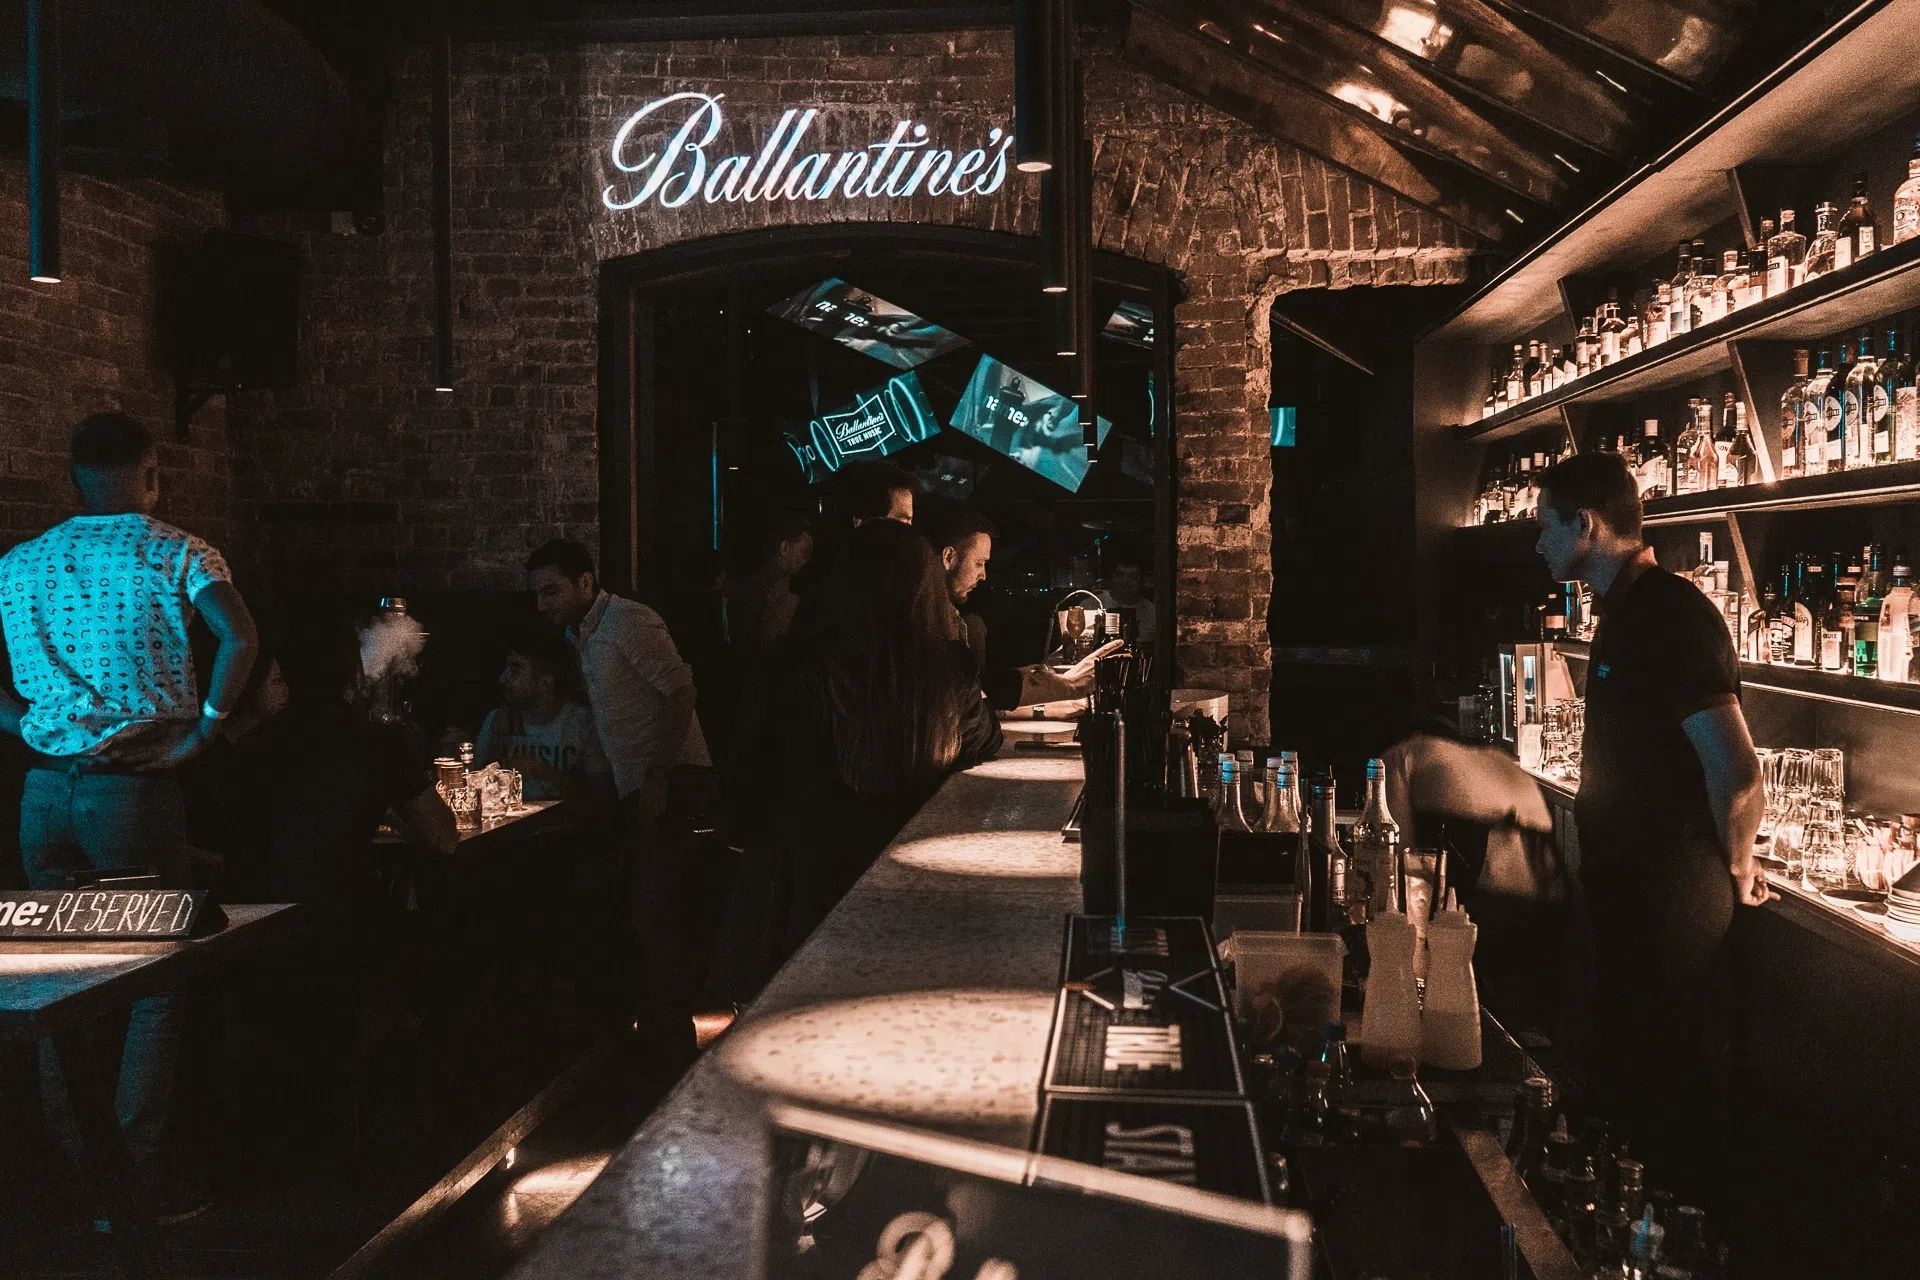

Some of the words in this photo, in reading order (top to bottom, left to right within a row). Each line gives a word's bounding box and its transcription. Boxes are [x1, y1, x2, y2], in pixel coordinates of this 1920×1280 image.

[602, 92, 1014, 211] Ballantine's
[847, 434, 862, 446] TRUE
[864, 427, 883, 440] MUSIC
[47, 892, 194, 933] RESERVED
[1103, 1024, 1183, 1071] TRUE
